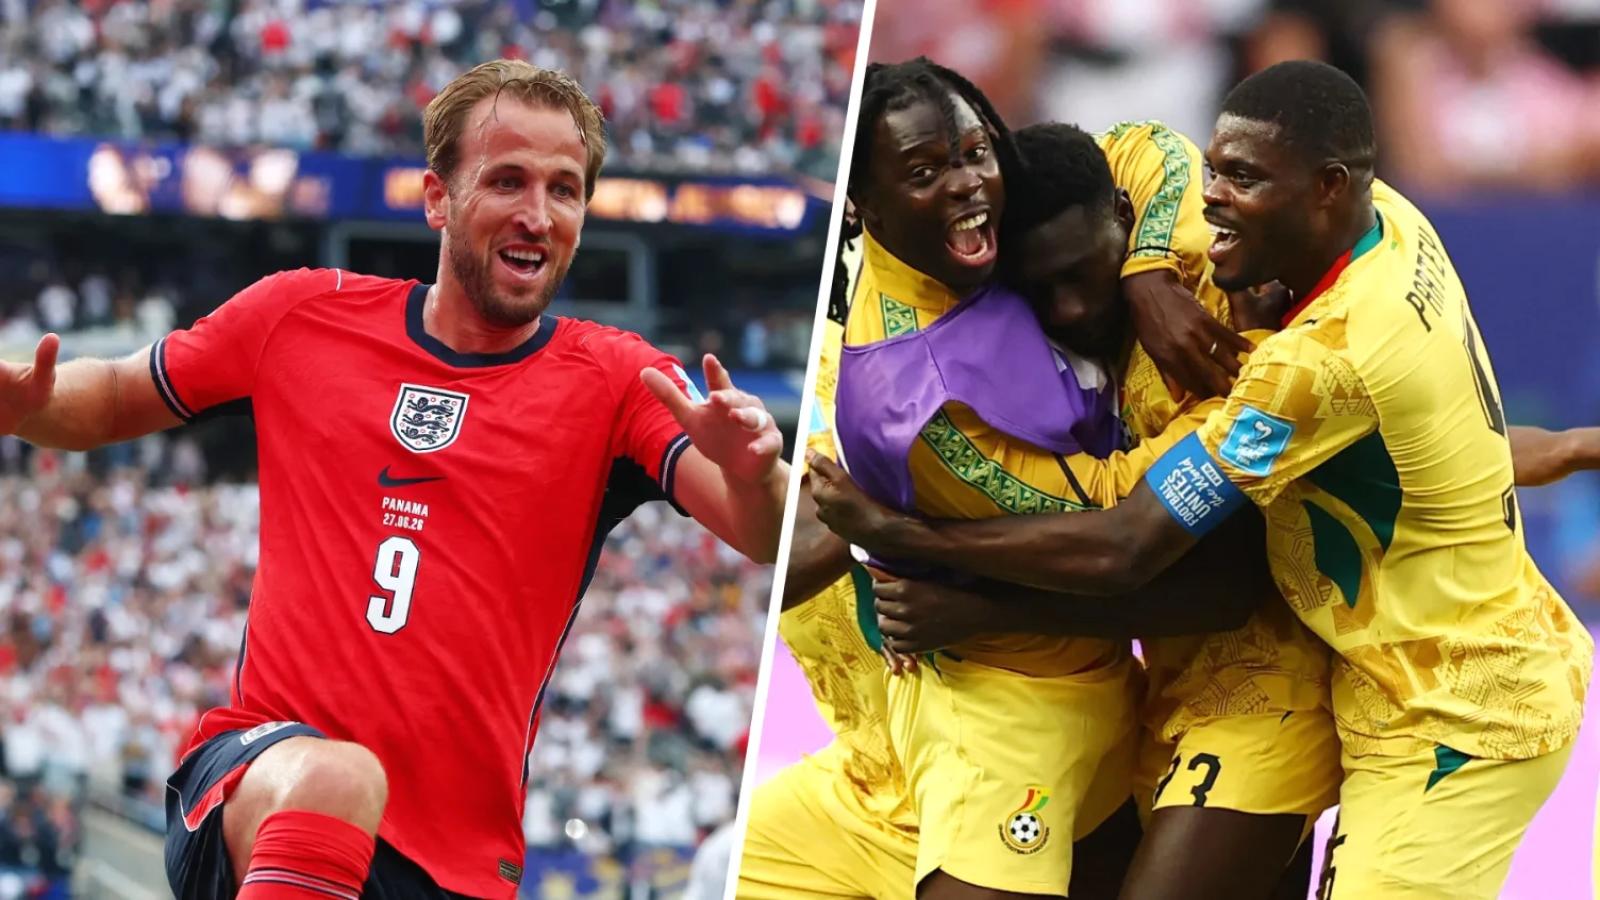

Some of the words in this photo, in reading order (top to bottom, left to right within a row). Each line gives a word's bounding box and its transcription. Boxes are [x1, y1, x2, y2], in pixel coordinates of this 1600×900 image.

[1405, 226, 1445, 333] PARTEY
[1167, 468, 1211, 519] UNITES
[1178, 456, 1210, 492] World
[382, 496, 429, 517] PANAMA
[1158, 480, 1199, 527] FOOTBALL
[1207, 488, 1225, 507] the
[382, 513, 424, 531] 27.06.26
[365, 535, 421, 636] 9
